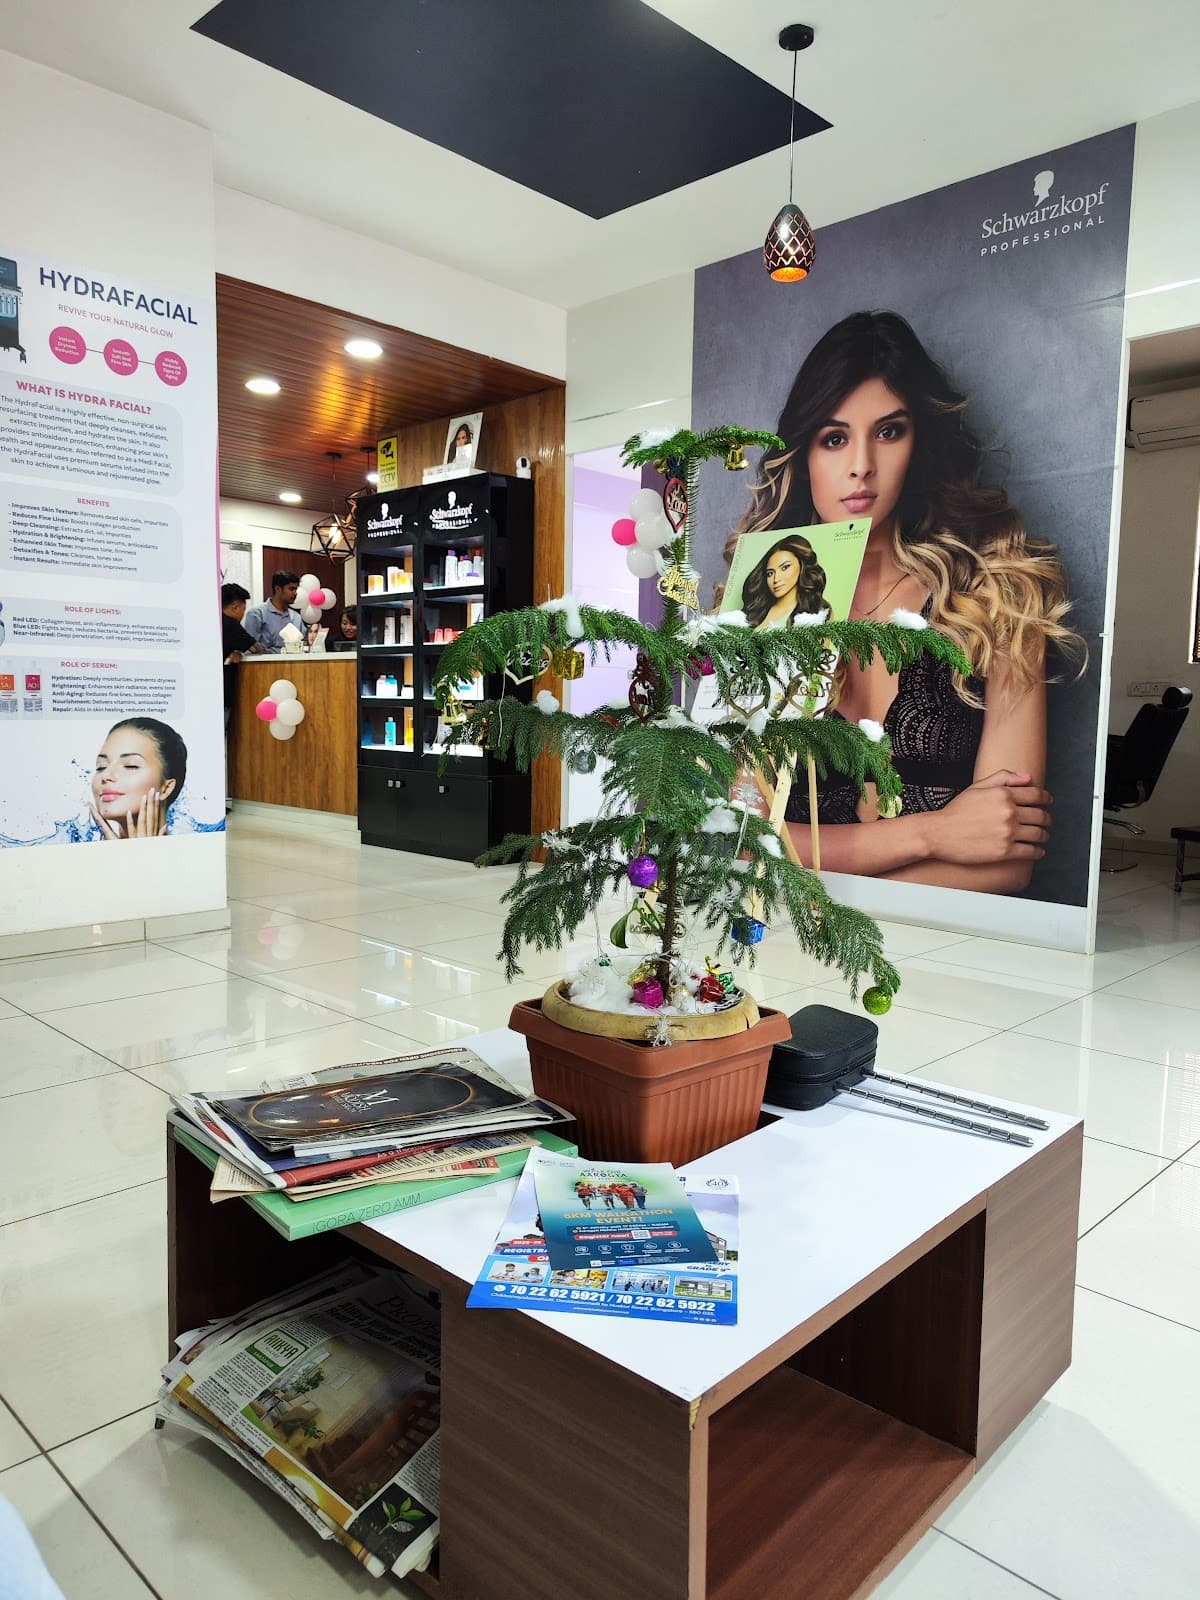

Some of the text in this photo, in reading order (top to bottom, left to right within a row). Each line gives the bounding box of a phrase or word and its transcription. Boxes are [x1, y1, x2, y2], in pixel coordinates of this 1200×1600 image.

[981, 182, 1109, 239] Schwarzkopf
[980, 215, 1105, 257] PROFESSIONAL
[39, 267, 198, 325] HYDRAFACIAL
[58, 303, 173, 338] REVIVE YOUR NATURAL GLOW
[16, 380, 152, 414] WHAT IS HYDRA FACIAL?
[77, 498, 109, 507] BENEFITS
[432, 503, 473, 520] Schwarzkopf
[368, 515, 404, 530] Schwarzkopf
[312, 1193, 421, 1232] IGORA ZERO AMM
[595, 1209, 673, 1218] WALKATHON
[510, 1286, 528, 1295] 70
[528, 1287, 548, 1297] 22
[549, 1288, 569, 1298] 62
[570, 1290, 606, 1302] 5921
[616, 1294, 633, 1304] 70
[635, 1296, 653, 1306] 22
[656, 1298, 675, 1308] 62
[678, 1300, 716, 1311] 5922
